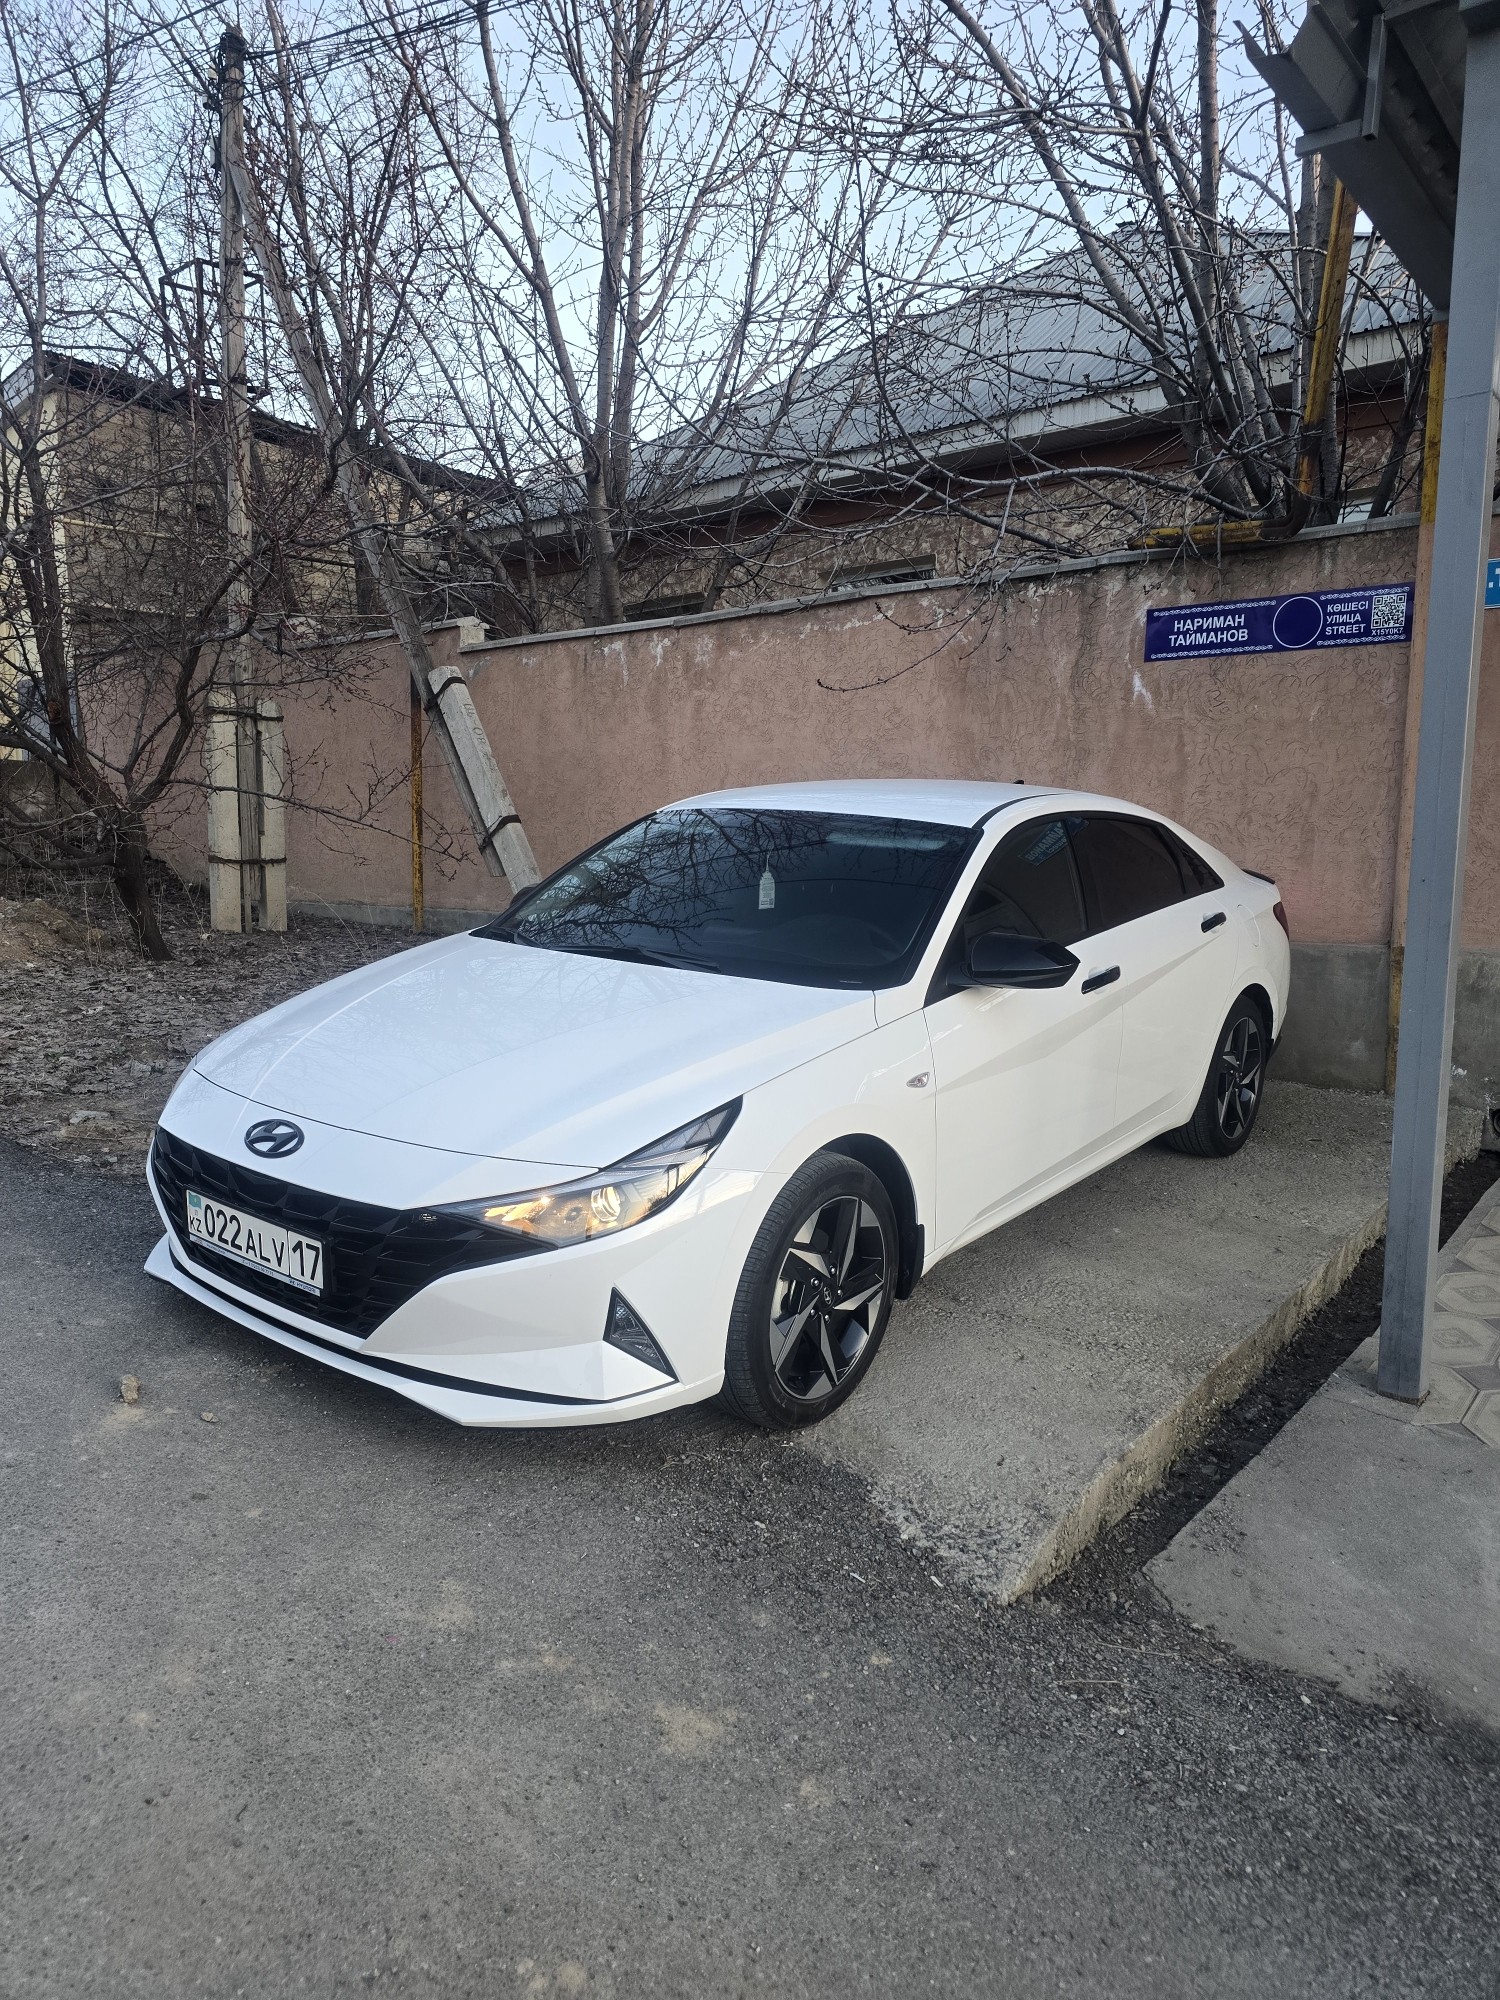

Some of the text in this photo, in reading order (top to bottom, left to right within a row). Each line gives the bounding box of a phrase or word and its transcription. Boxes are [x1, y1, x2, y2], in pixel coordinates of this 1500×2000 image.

[1327, 601, 1369, 613] КӨШЕСІ
[1174, 614, 1245, 632] НАРИМАН
[1326, 613, 1362, 624] УЛИЦА
[1325, 624, 1367, 635] STREET
[1168, 629, 1249, 647] ТАЙМАНОВ
[190, 1215, 202, 1233] KZ
[292, 1240, 321, 1281] 17
